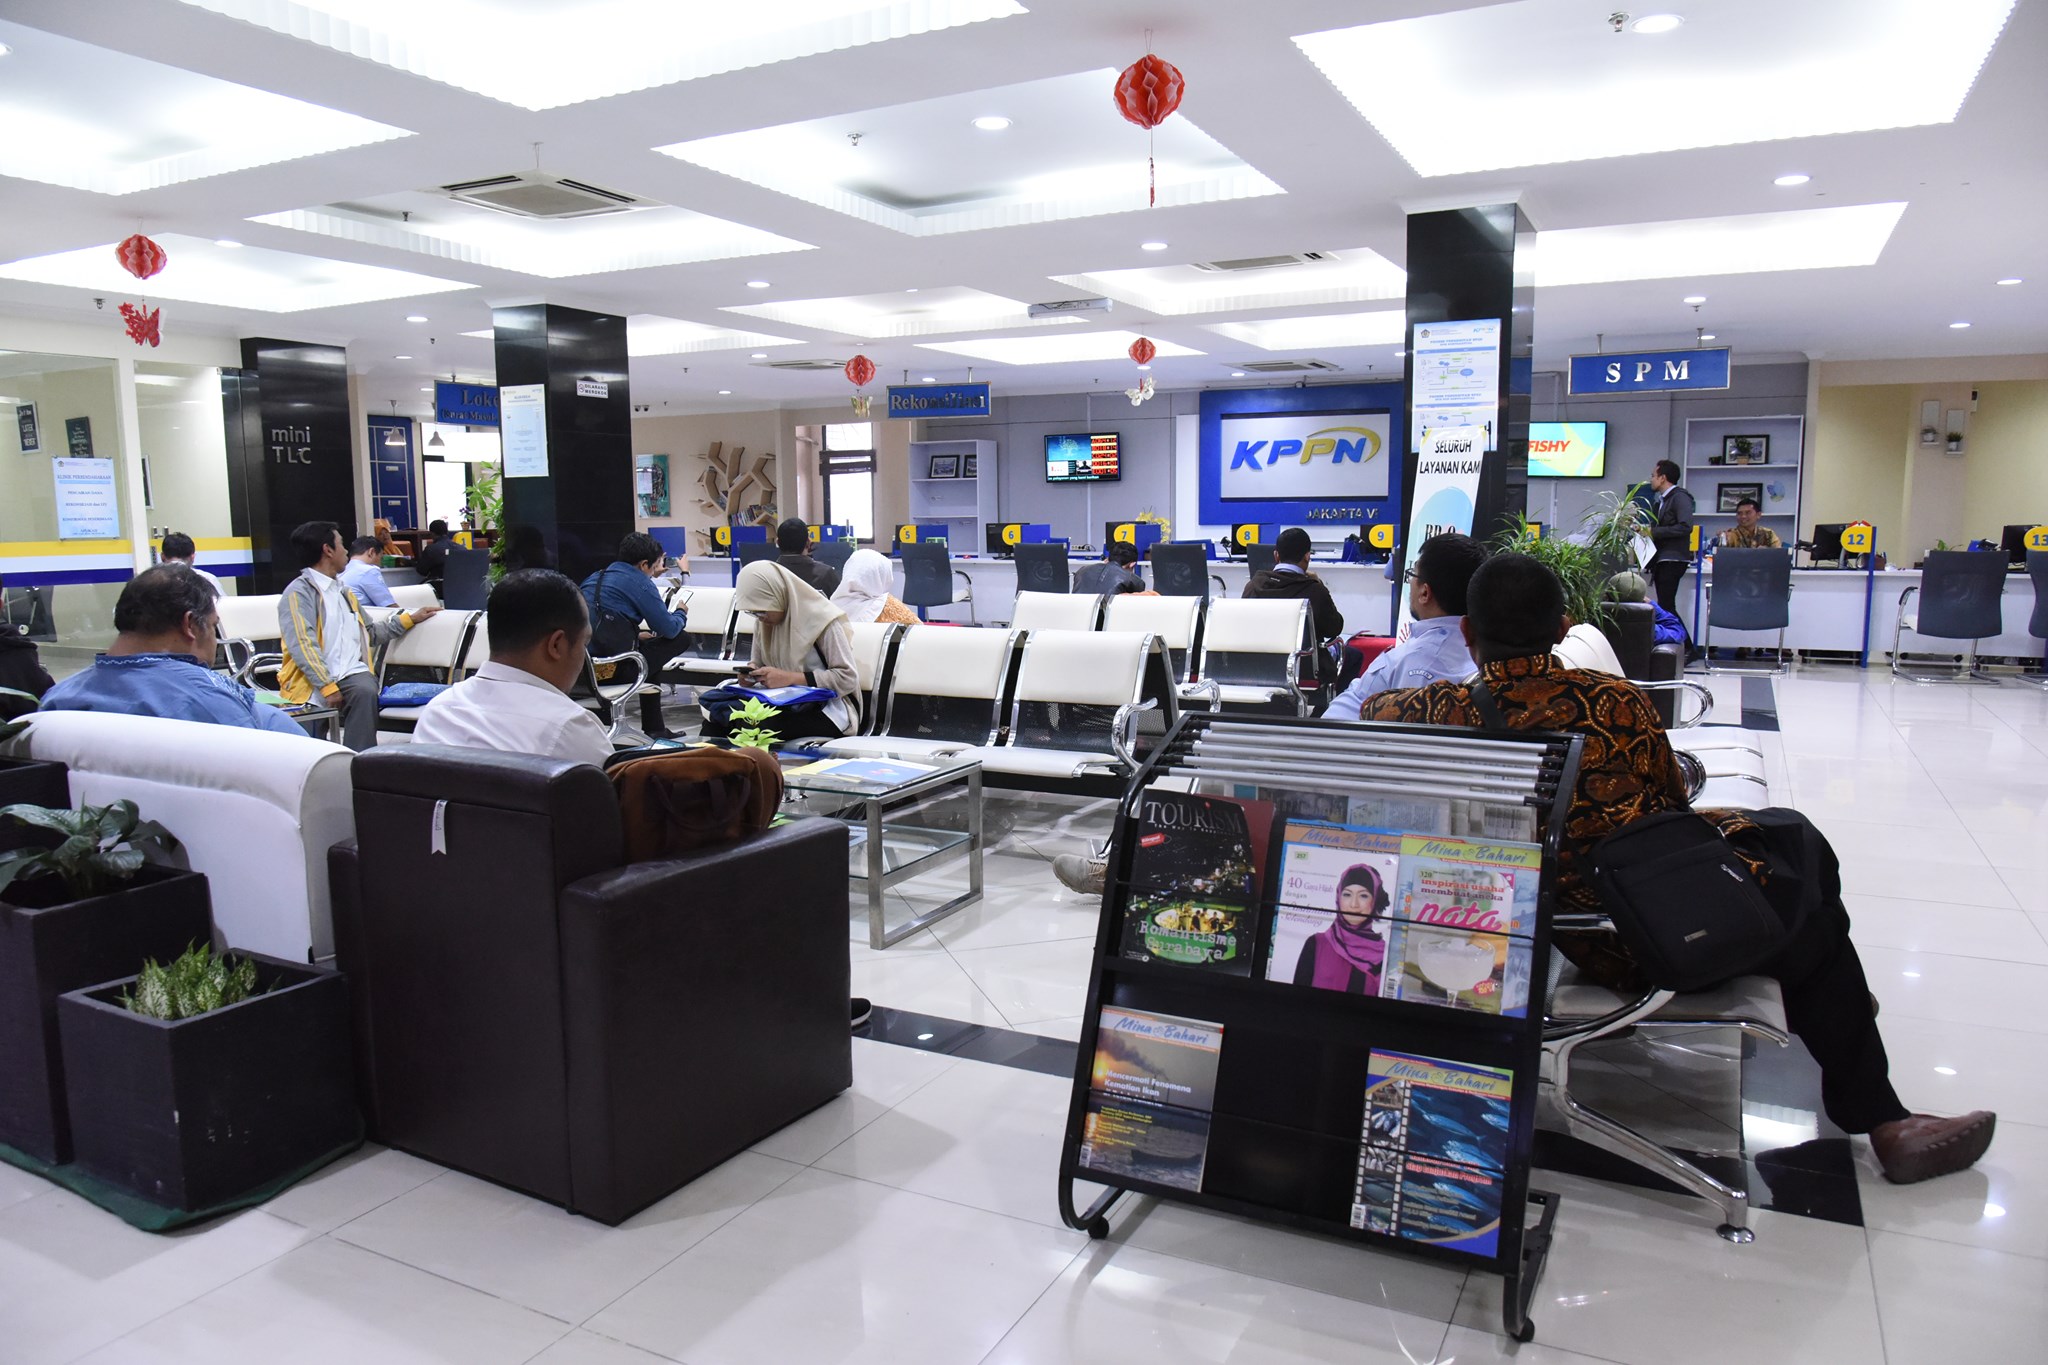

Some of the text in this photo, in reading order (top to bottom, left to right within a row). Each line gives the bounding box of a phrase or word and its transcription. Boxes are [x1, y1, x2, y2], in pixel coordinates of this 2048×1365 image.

[272, 426, 310, 443] mini
[1434, 440, 1472, 454] SELURUH
[1528, 440, 1572, 452] FISHY
[272, 446, 312, 464] TLC
[1230, 438, 1366, 470] KPPN
[1420, 460, 1460, 474] LAYANAN
[721, 532, 727, 540] 3
[809, 531, 815, 540] 4
[905, 532, 911, 540] 5
[1008, 531, 1014, 539] 6
[1122, 531, 1128, 540] 7
[1244, 531, 1251, 540] 8
[1377, 531, 1385, 541] 9
[1847, 534, 1865, 545] 12
[2032, 534, 2048, 546] 13
[1301, 829, 1340, 844] Mina
[1417, 841, 1528, 863] Mina Bahari
[1286, 876, 1302, 889] 40
[1421, 878, 1505, 893] inspirasi usaha
[1421, 887, 1504, 901] membuat aneka
[1416, 902, 1502, 932] nata
[1139, 920, 1237, 946] Romantisme
[1146, 937, 1224, 961] Surabaya
[1114, 1016, 1152, 1034] Mina
[1163, 1025, 1209, 1044] Bahari
[1106, 1069, 1191, 1093] Mencermati Fenomena
[1385, 1061, 1429, 1080] Mina
[1442, 1070, 1496, 1090] Bahari
[1104, 1079, 1160, 1097] Kematian Ikan
